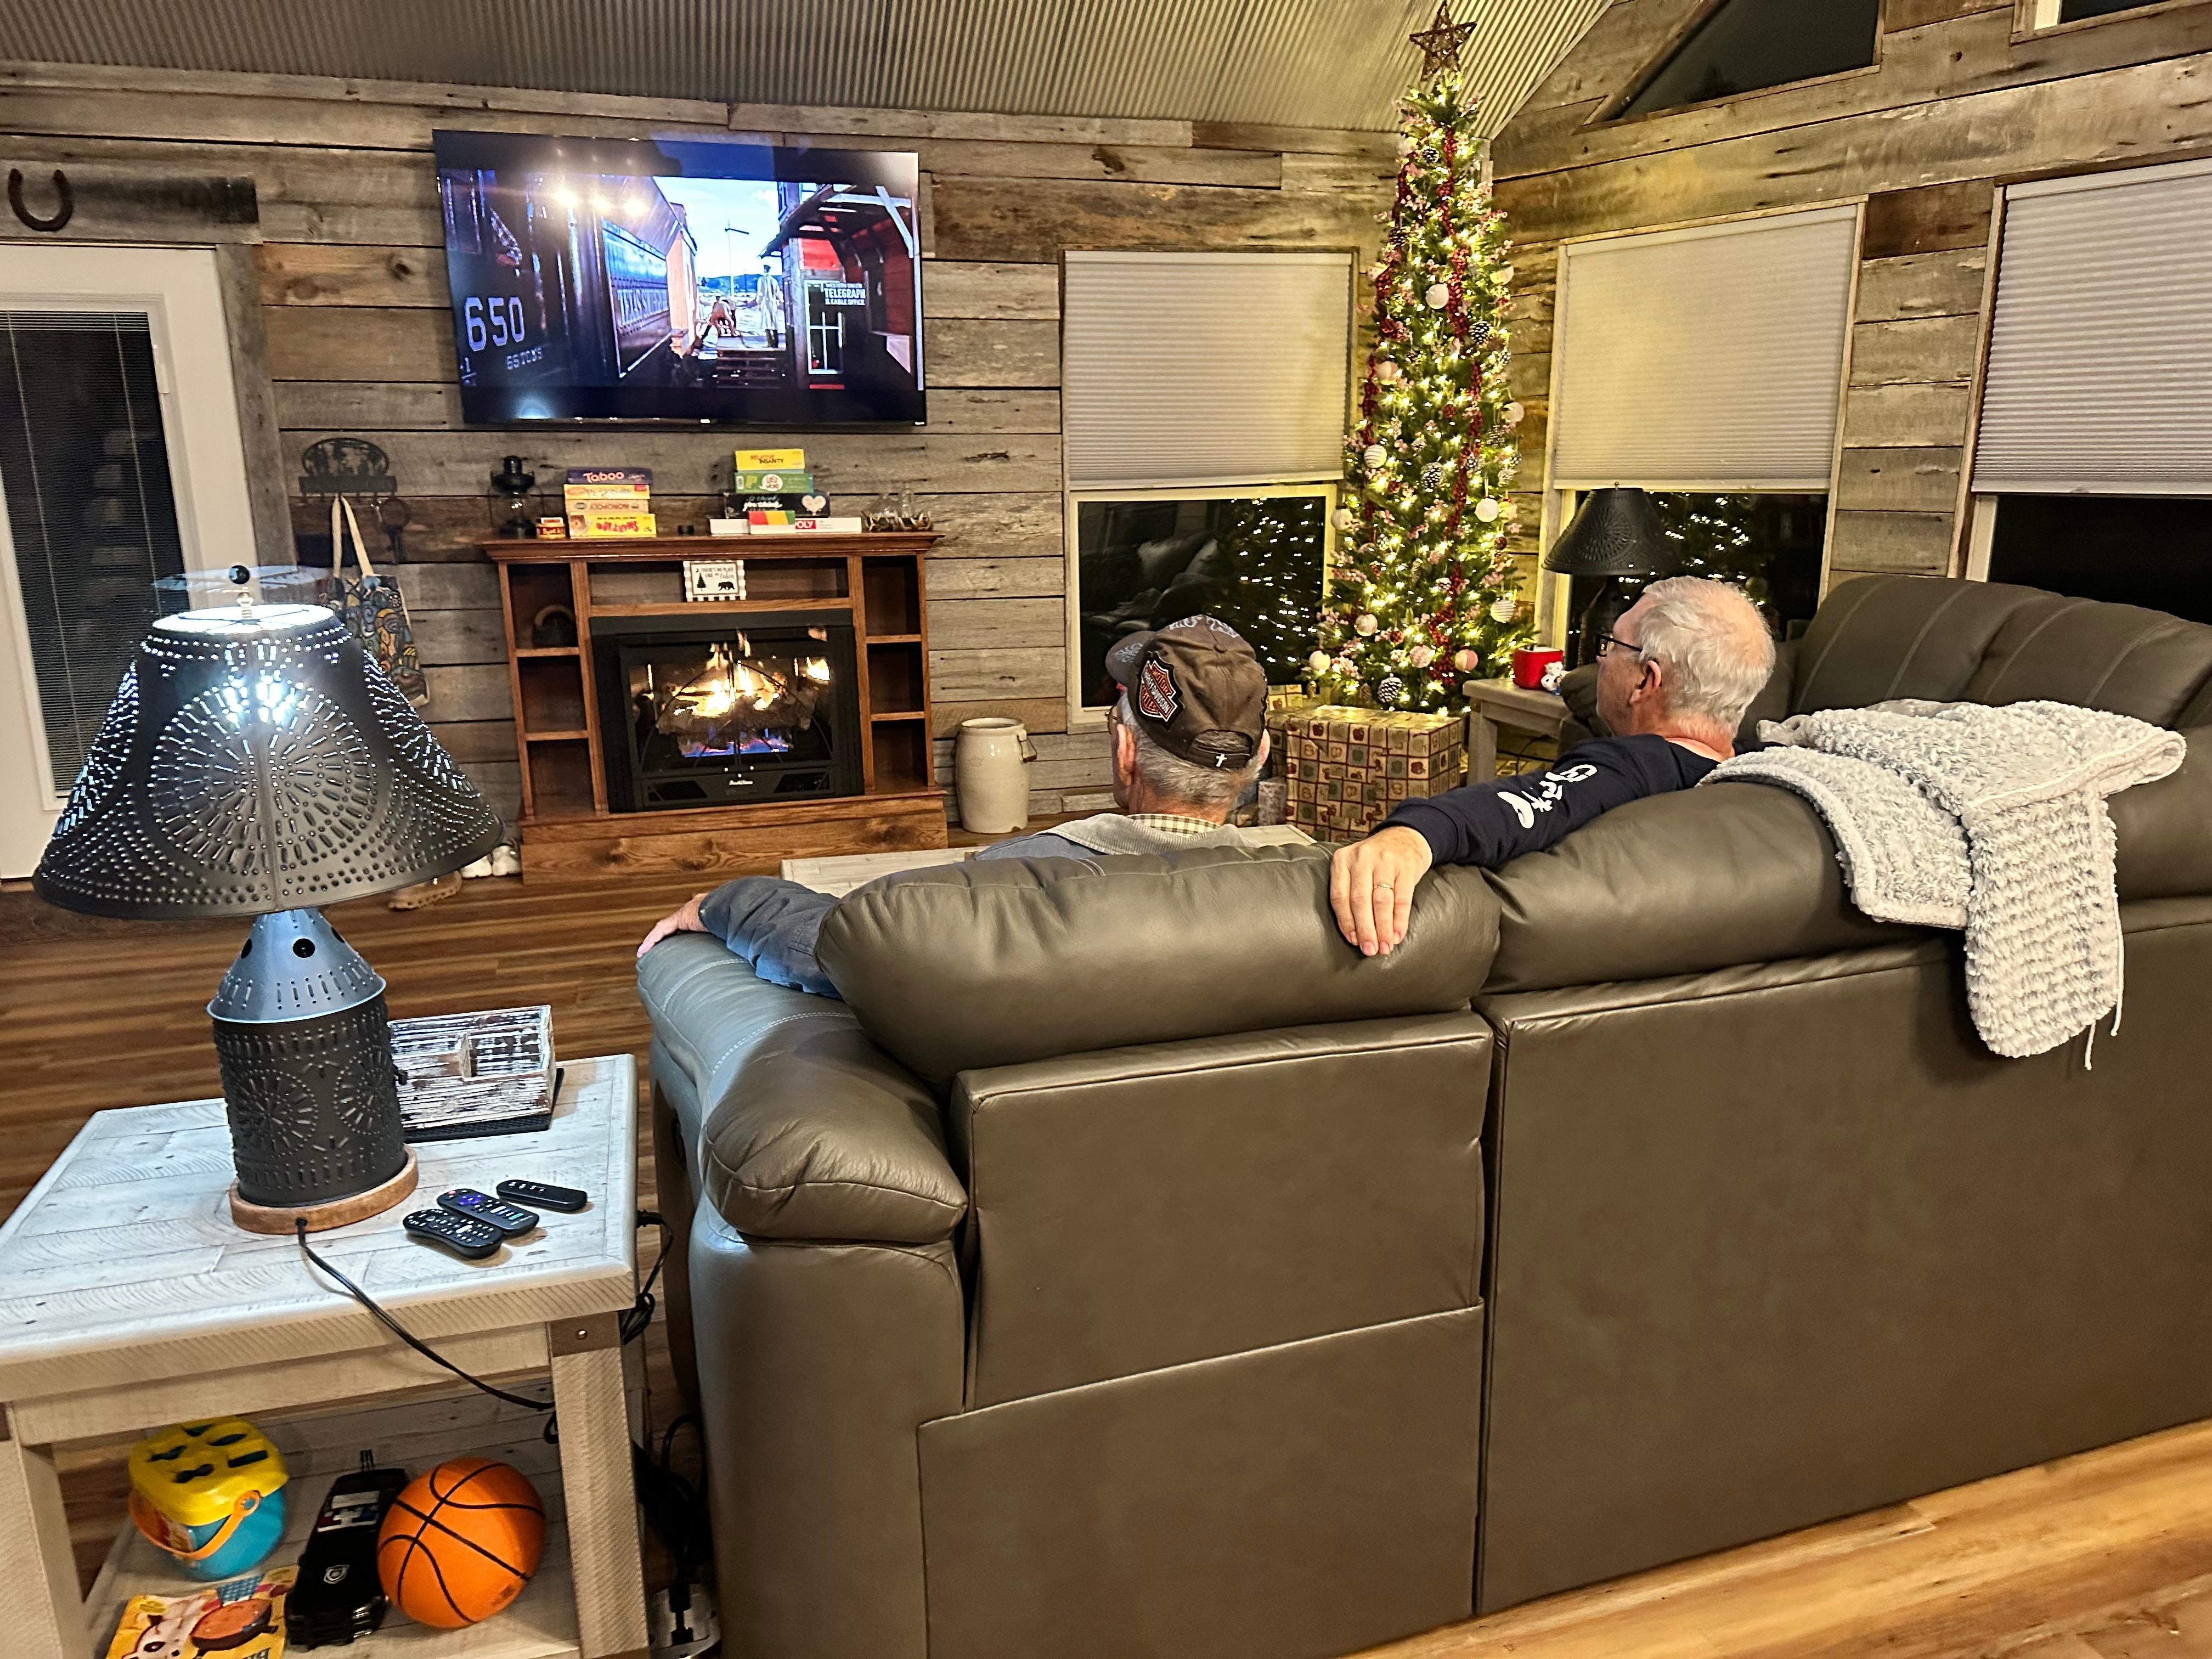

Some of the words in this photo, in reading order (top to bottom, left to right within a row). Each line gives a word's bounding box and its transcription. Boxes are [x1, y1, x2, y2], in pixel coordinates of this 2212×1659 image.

[824, 288, 866, 299] TELEGRAPH
[464, 296, 525, 352] 650
[583, 471, 625, 483] Taboo
